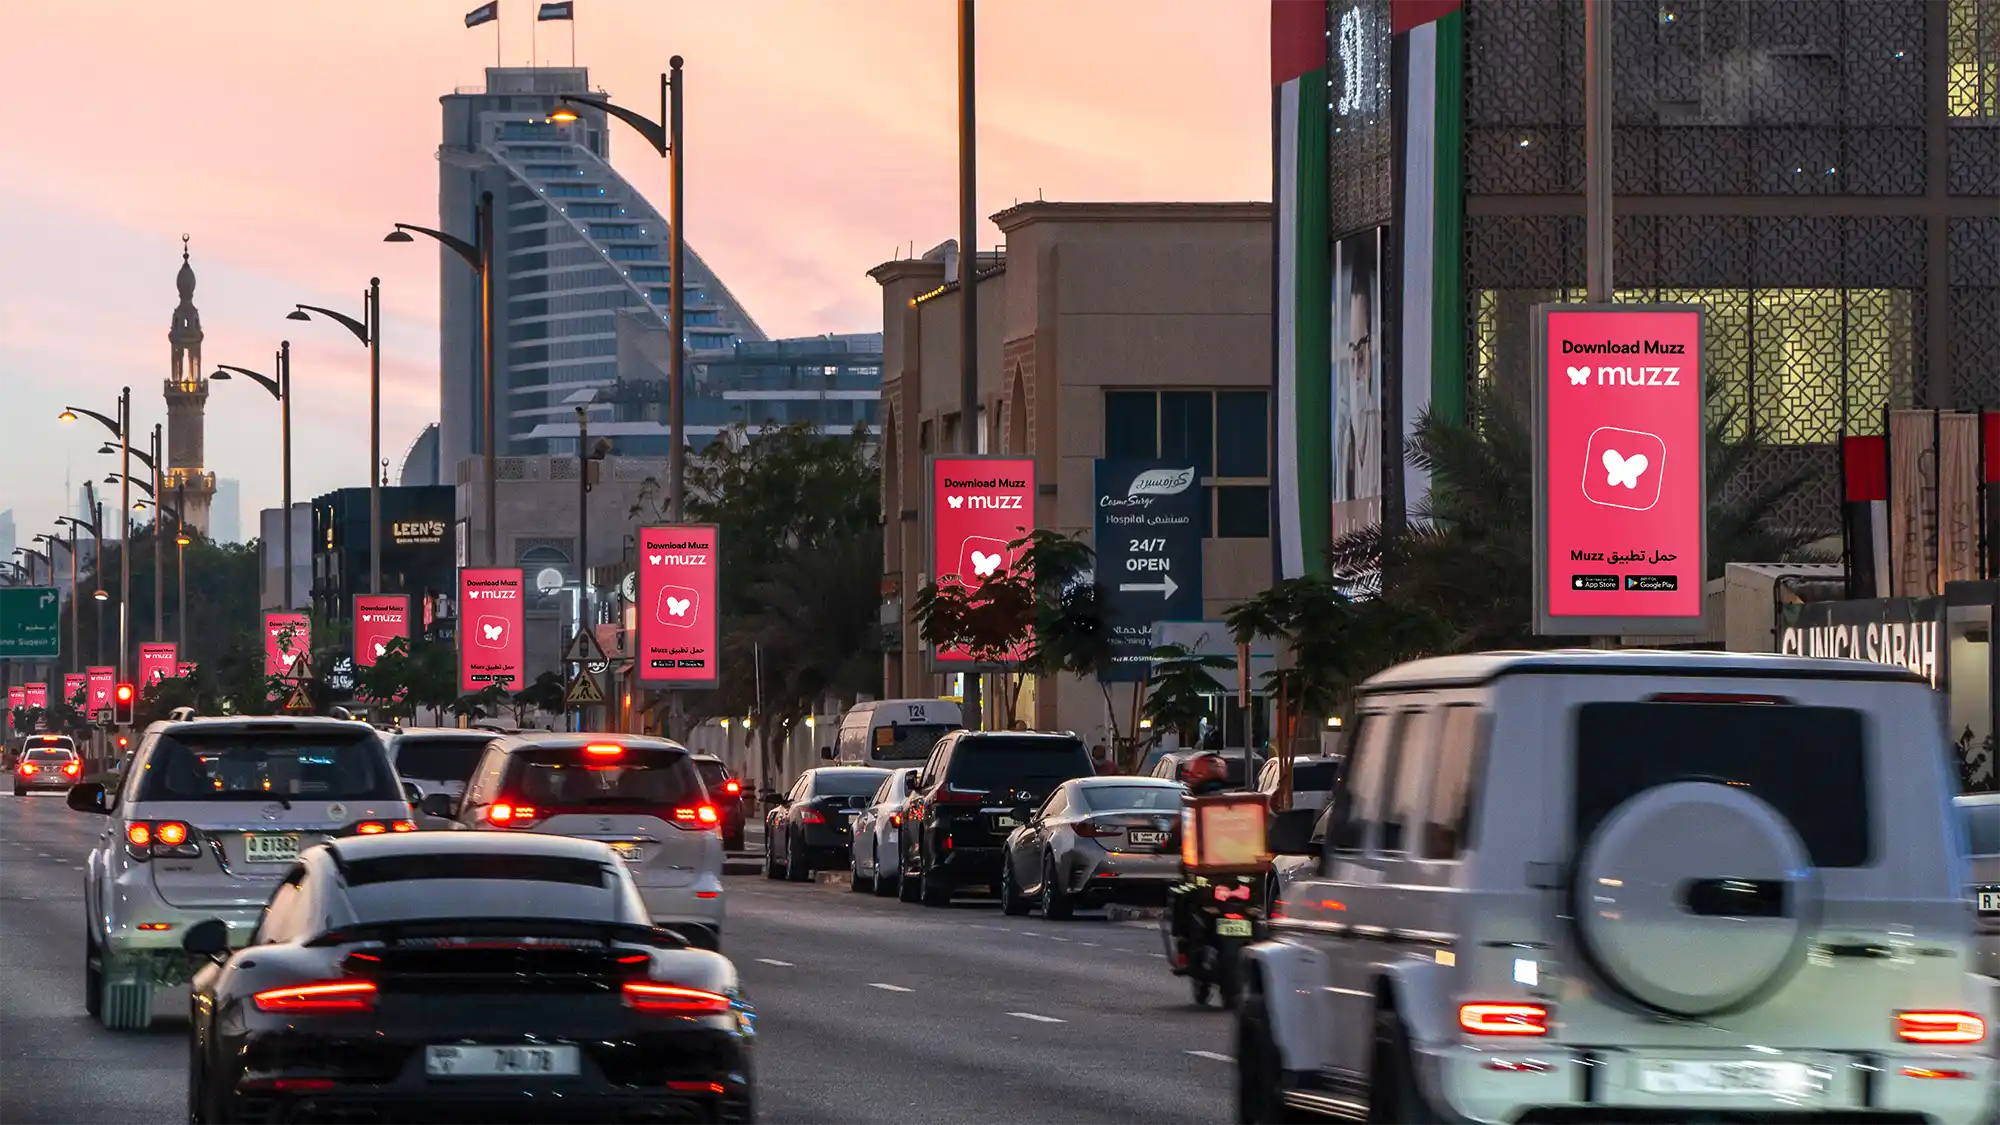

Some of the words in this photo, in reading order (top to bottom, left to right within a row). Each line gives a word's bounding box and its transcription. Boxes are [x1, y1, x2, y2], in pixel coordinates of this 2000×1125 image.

[1562, 340, 1640, 354] Download
[1644, 340, 1685, 354] Muzz
[1598, 366, 1680, 386] muzz
[944, 478, 996, 488] Download
[998, 478, 1026, 488] Muzz
[967, 495, 1022, 509] muzz
[1100, 495, 1156, 508] CosmeSurge
[1106, 514, 1145, 525] Hospital
[394, 521, 444, 536] LEEN'S
[1129, 538, 1166, 552] 24/7
[664, 555, 707, 565] muzz
[1571, 550, 1604, 561] Muzz
[1607, 550, 1645, 564] تطبيق
[1648, 550, 1677, 564] حمل
[1126, 558, 1170, 571] OPEN
[1640, 581, 1661, 589] Google
[1662, 581, 1675, 589] Play
[481, 590, 516, 599] muzz
[373, 614, 402, 622] muzz
[51, 637, 57, 646] 2
[908, 705, 925, 717] T24
[1133, 833, 1140, 842] N
[1983, 894, 1992, 909] R
